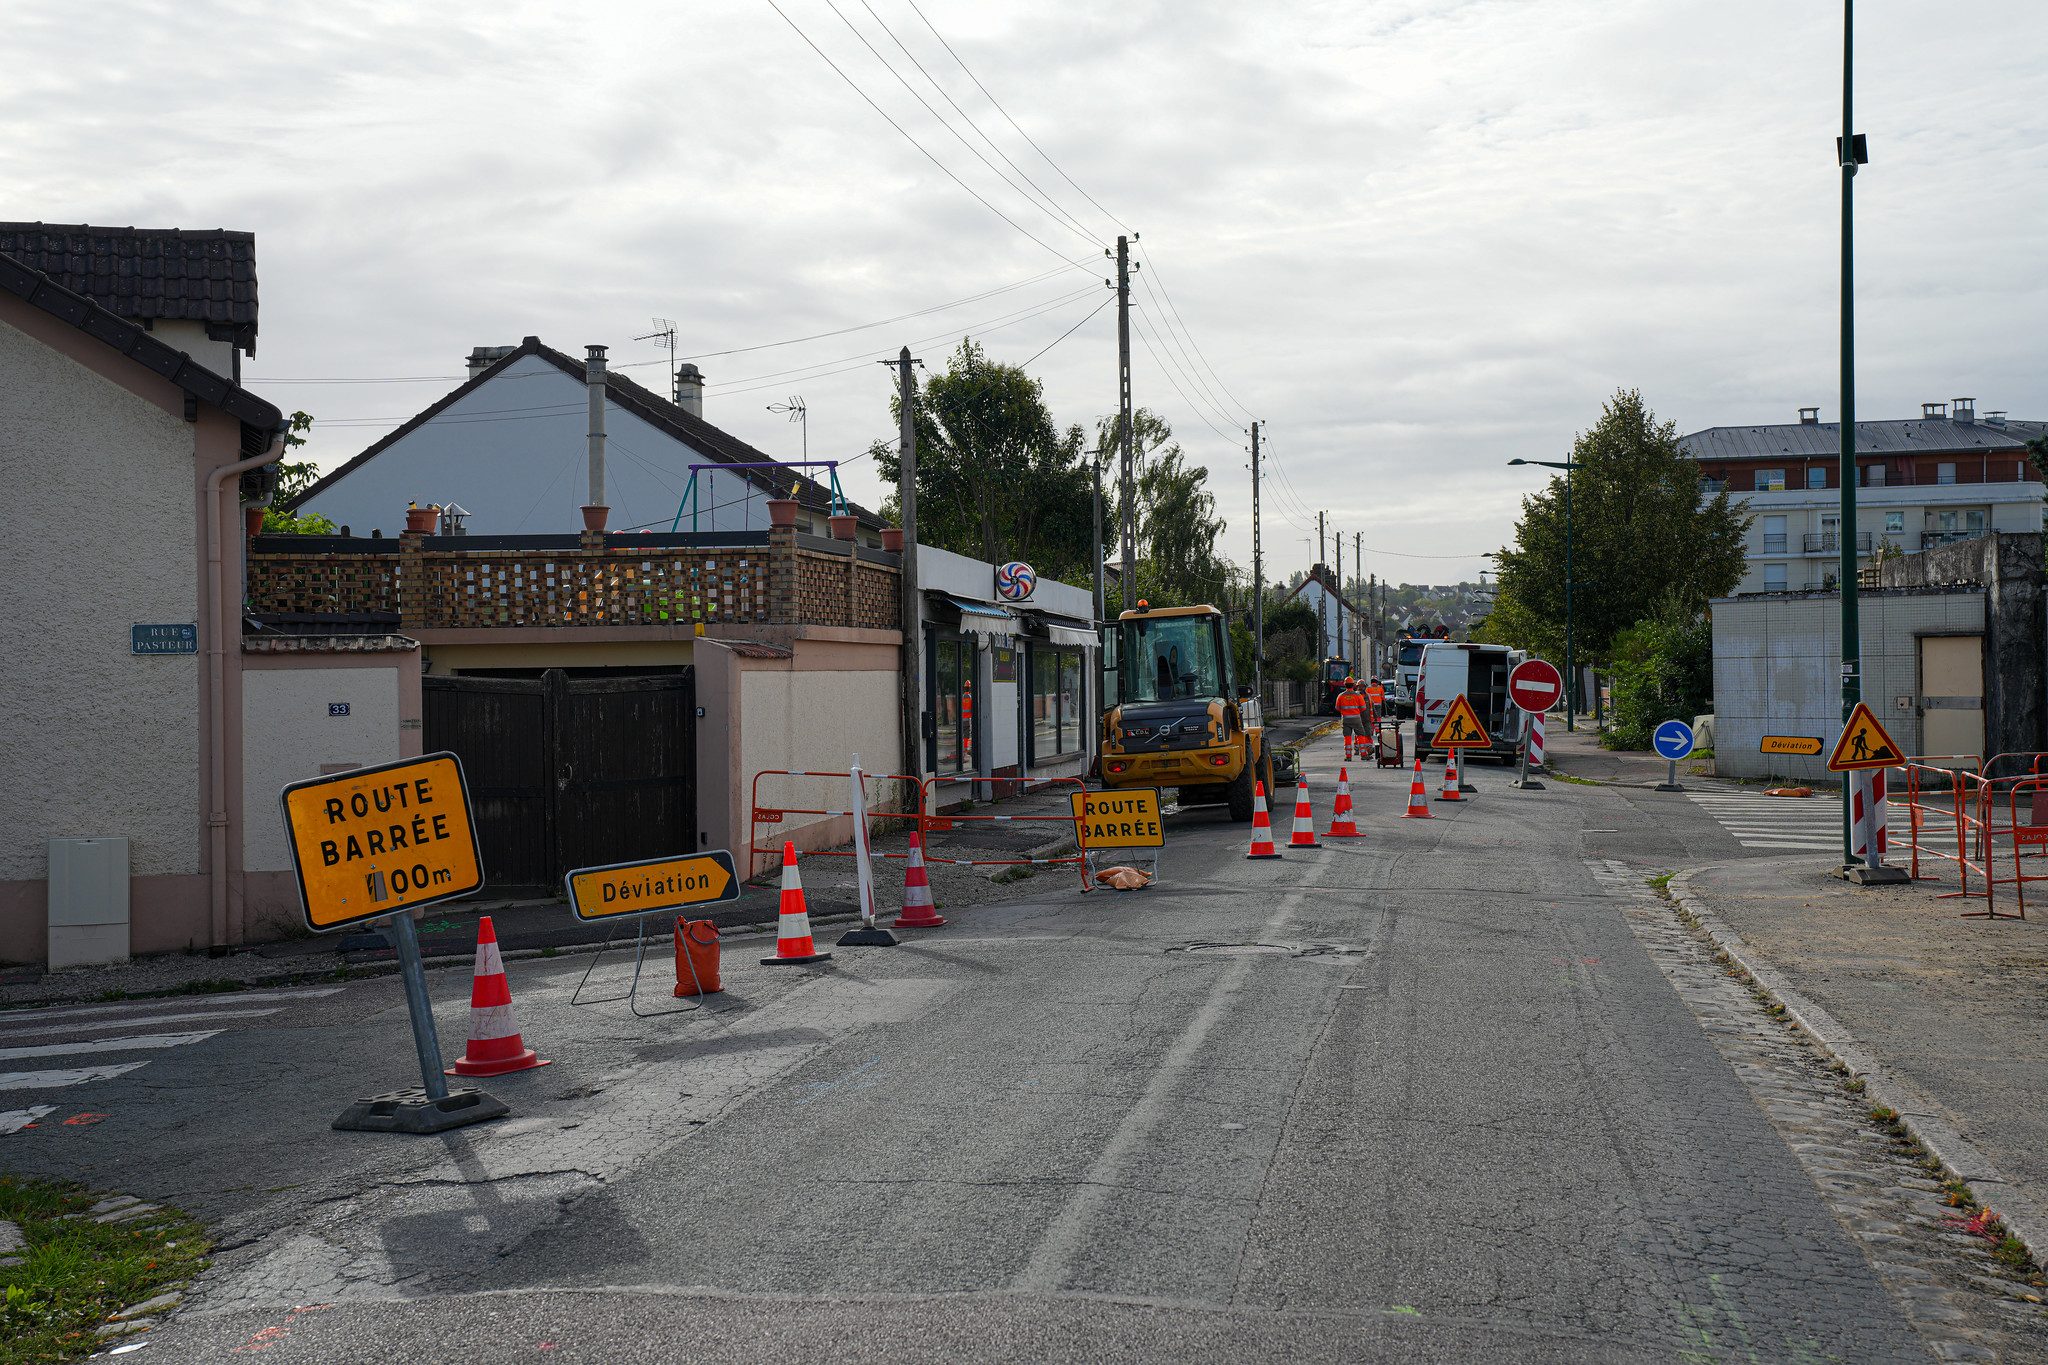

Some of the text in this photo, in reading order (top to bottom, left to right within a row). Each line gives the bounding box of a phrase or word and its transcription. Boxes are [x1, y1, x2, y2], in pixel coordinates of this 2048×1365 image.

[151, 628, 179, 636] RUE
[136, 641, 193, 650] PASTEUR
[332, 705, 347, 714] 33
[1771, 741, 1813, 750] Déviation
[325, 777, 433, 825] ROUTE
[1085, 800, 1147, 816] ROUTE
[1080, 820, 1158, 838] BARRÉE
[320, 814, 450, 867] BARRÉE
[603, 873, 709, 903] Déviation
